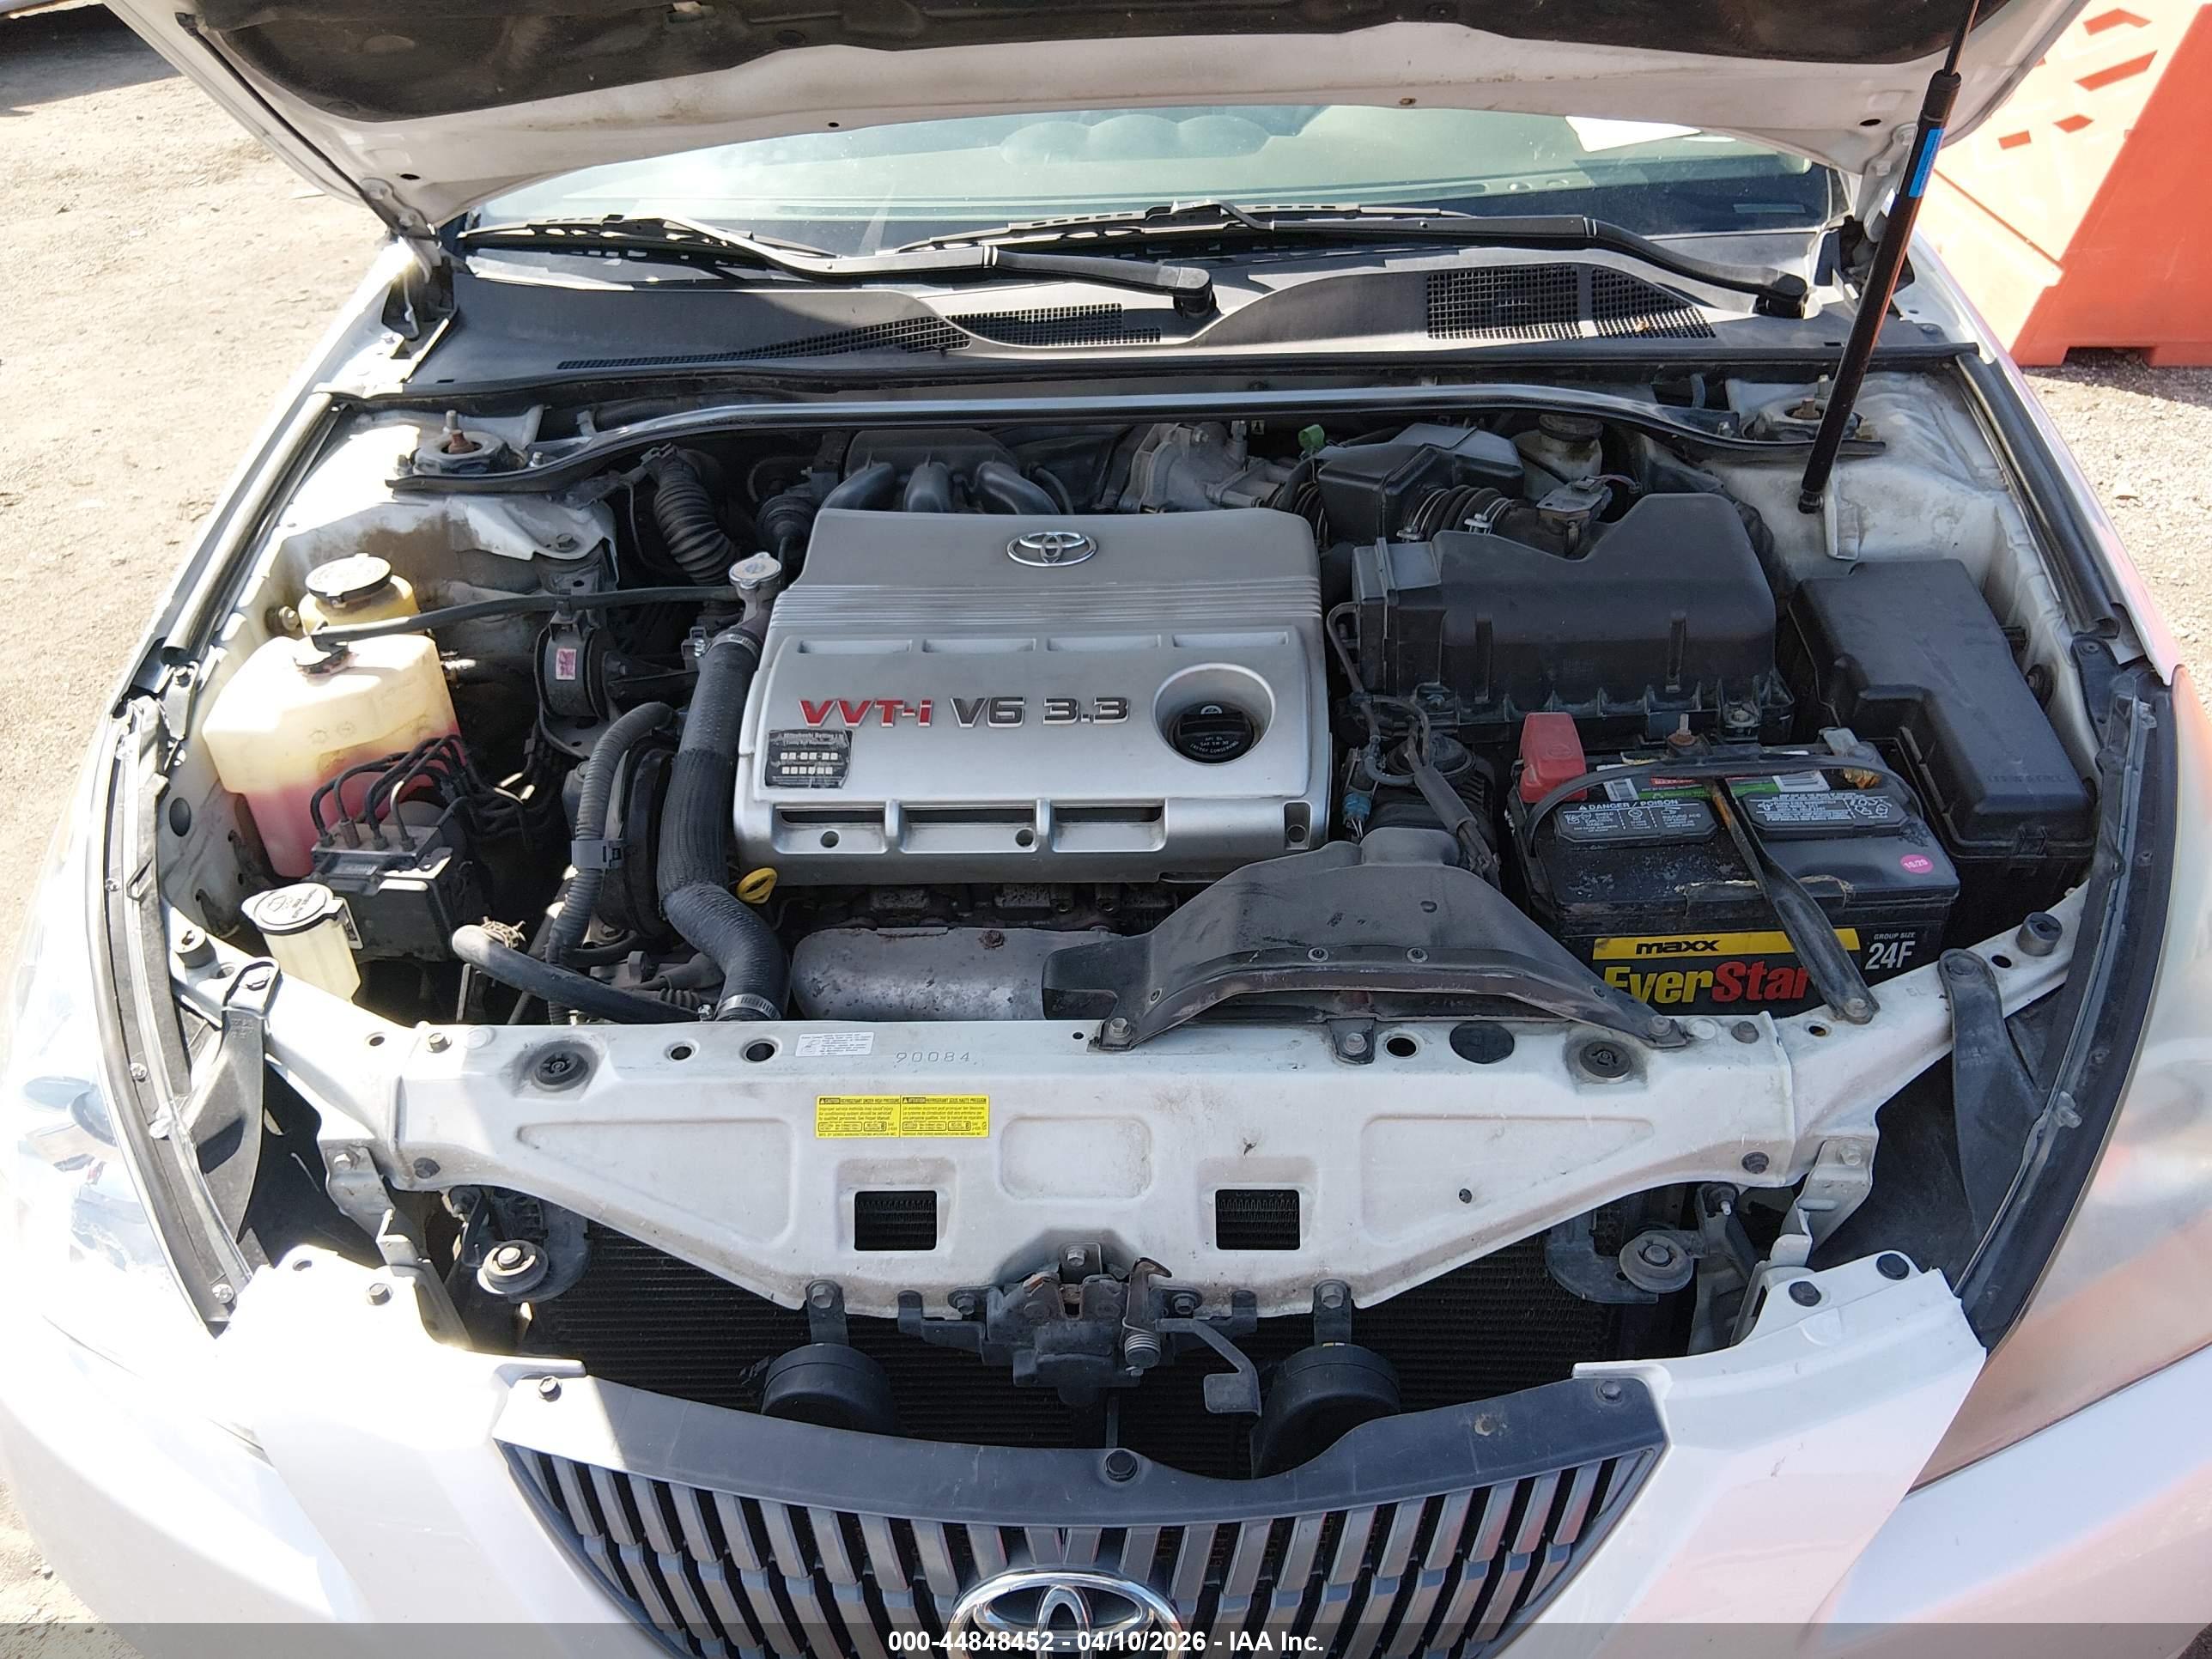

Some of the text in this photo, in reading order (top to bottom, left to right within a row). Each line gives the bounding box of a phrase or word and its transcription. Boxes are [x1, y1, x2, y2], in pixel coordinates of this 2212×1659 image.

[799, 696, 1131, 727] VVT-i V6 3.3
[1589, 802, 1630, 811] DANGER
[1635, 939, 1720, 955] maxx
[1864, 940, 1916, 970] 24F
[1604, 961, 1809, 1005] EverStar
[896, 1050, 970, 1064] 90084
